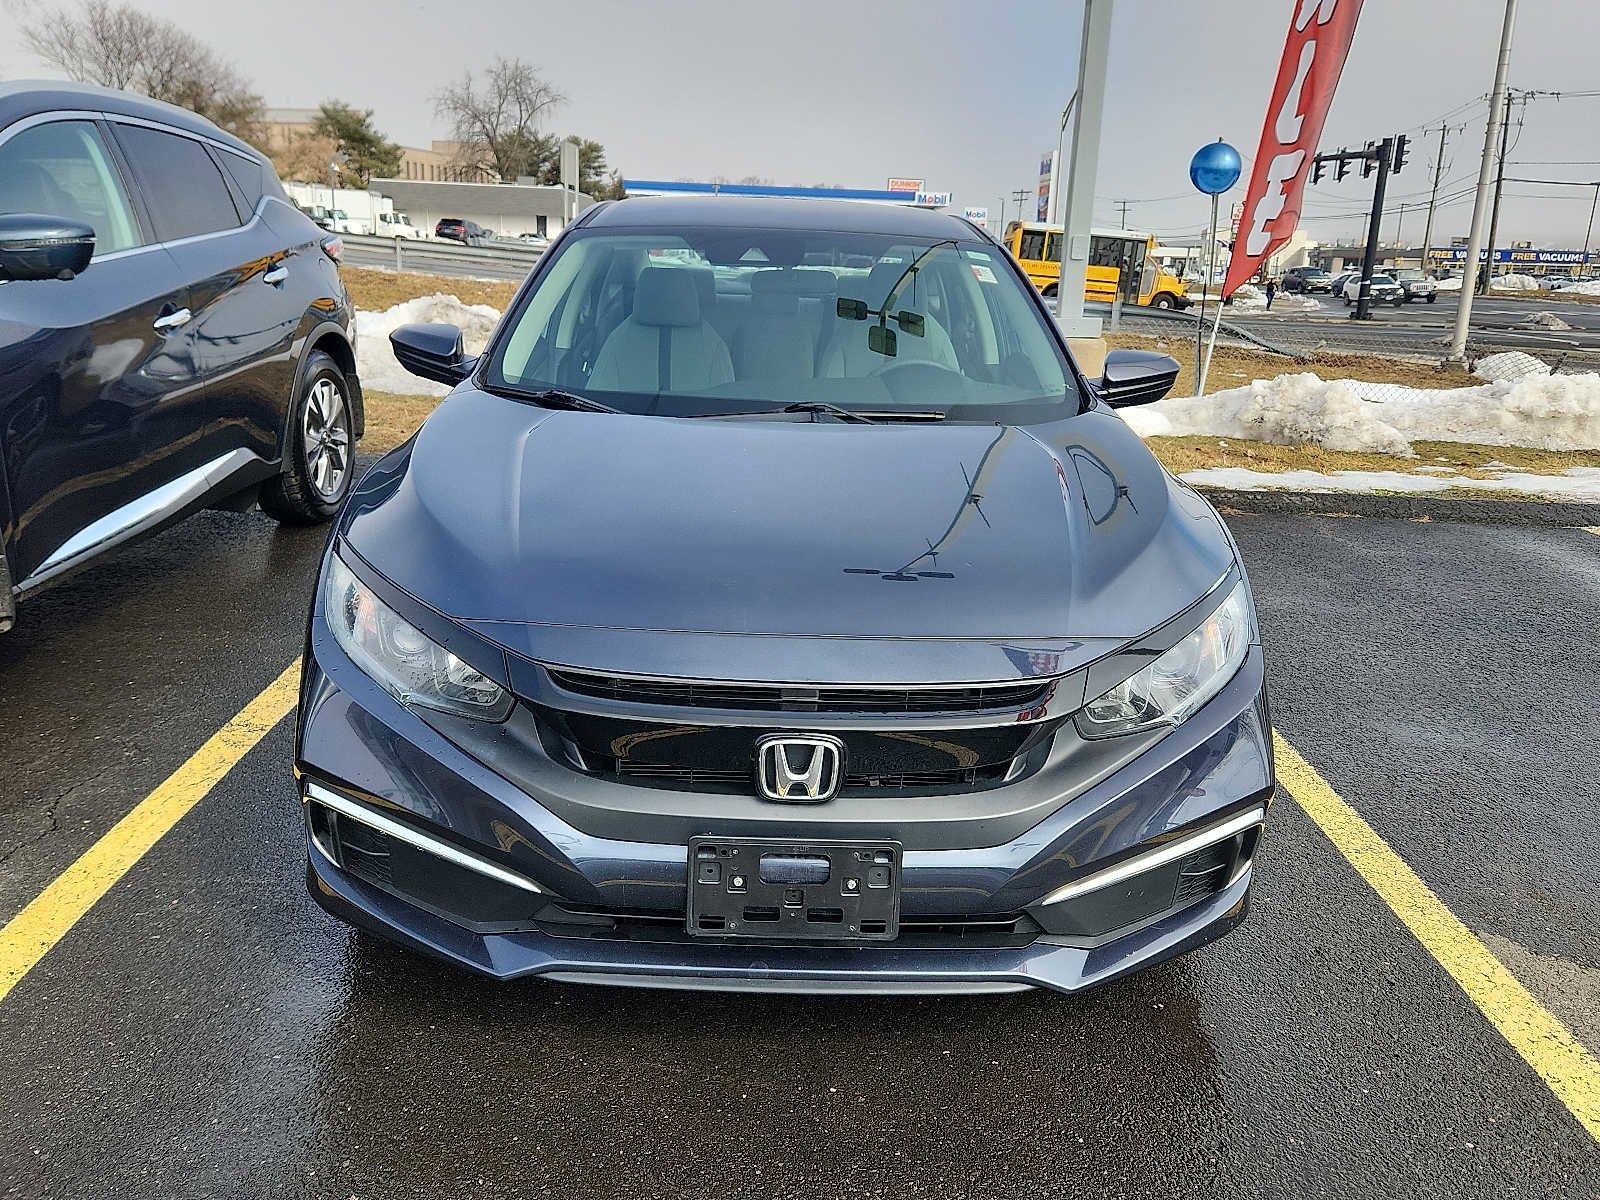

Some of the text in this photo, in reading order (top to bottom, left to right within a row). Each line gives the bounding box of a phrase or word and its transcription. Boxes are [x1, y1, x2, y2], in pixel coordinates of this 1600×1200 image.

[918, 194, 947, 204] Mobil
[1428, 250, 1501, 260] FREE VAUS
[1511, 252, 1584, 262] FREE VACUUMS
